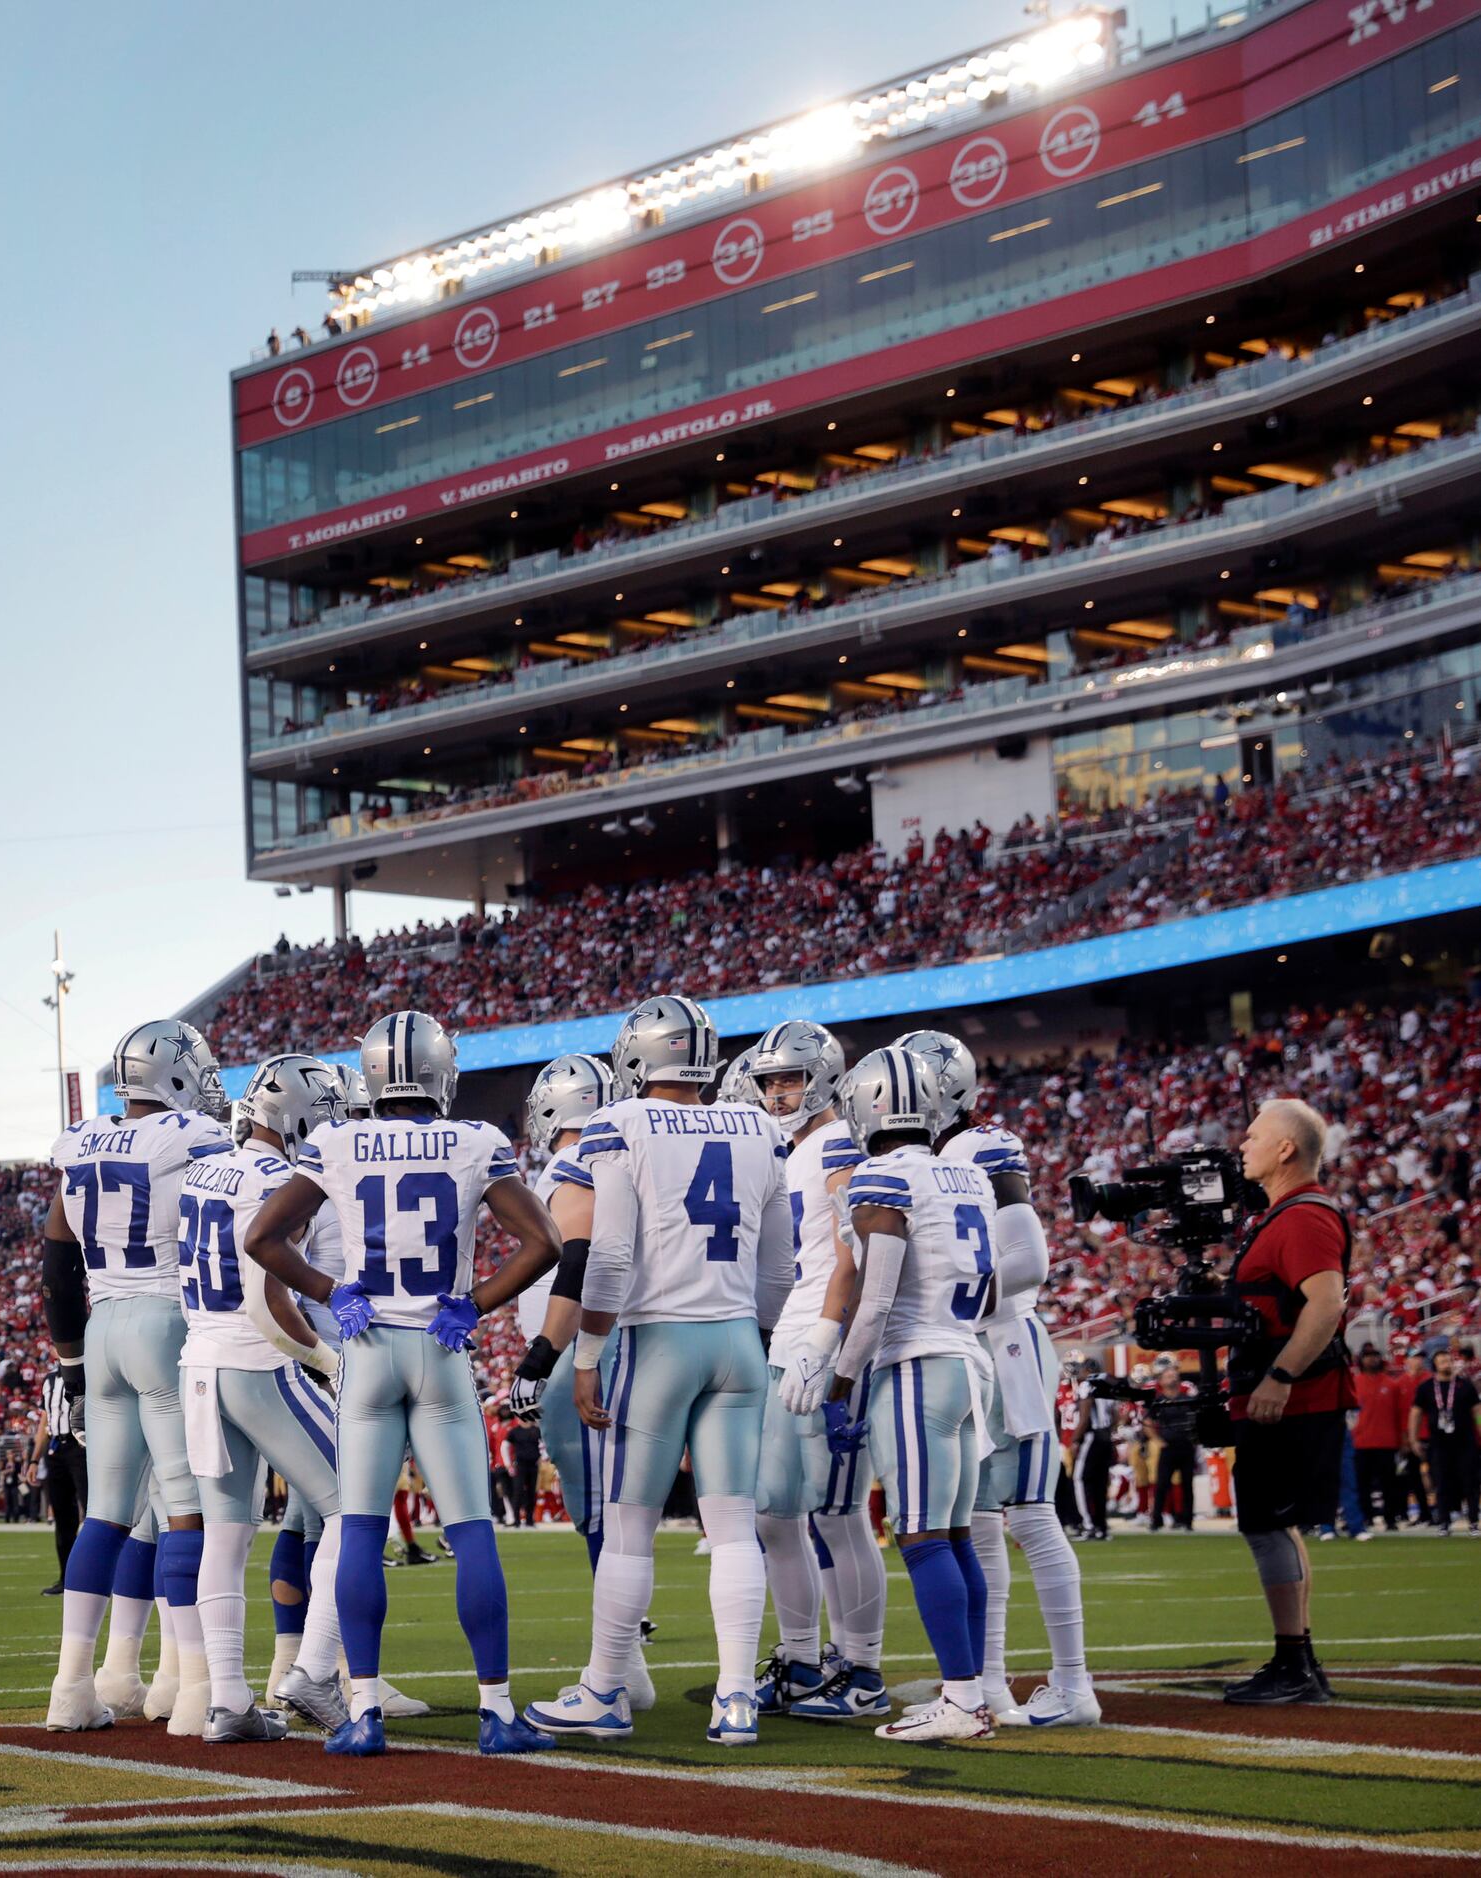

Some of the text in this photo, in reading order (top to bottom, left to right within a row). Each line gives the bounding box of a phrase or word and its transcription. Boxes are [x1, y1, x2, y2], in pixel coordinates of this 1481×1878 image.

[342, 361, 373, 389] 12
[460, 322, 493, 351] 16
[523, 302, 557, 331] 21
[581, 280, 620, 311] 27
[646, 259, 686, 290] 33
[716, 237, 759, 267] 34
[868, 181, 914, 215] 37
[953, 152, 1002, 187] 39
[1044, 123, 1096, 158] 42
[1132, 91, 1186, 127] 44
[1308, 191, 1407, 249] 21-TIME
[740, 399, 776, 422] JR.
[458, 457, 569, 502] MORABITO
[288, 504, 408, 550] T. MORABITO
[384, 1085, 418, 1094] COWBOYS
[77, 1129, 138, 1159] SMITH
[646, 1107, 766, 1137] PRESCOTT
[355, 1131, 459, 1162] GALLUP
[683, 1141, 741, 1263] 4
[931, 1166, 984, 1197] COOKS
[65, 1161, 157, 1270] 77
[355, 1171, 459, 1297] 13
[178, 1193, 243, 1312] 20
[950, 1203, 993, 1322] 3
